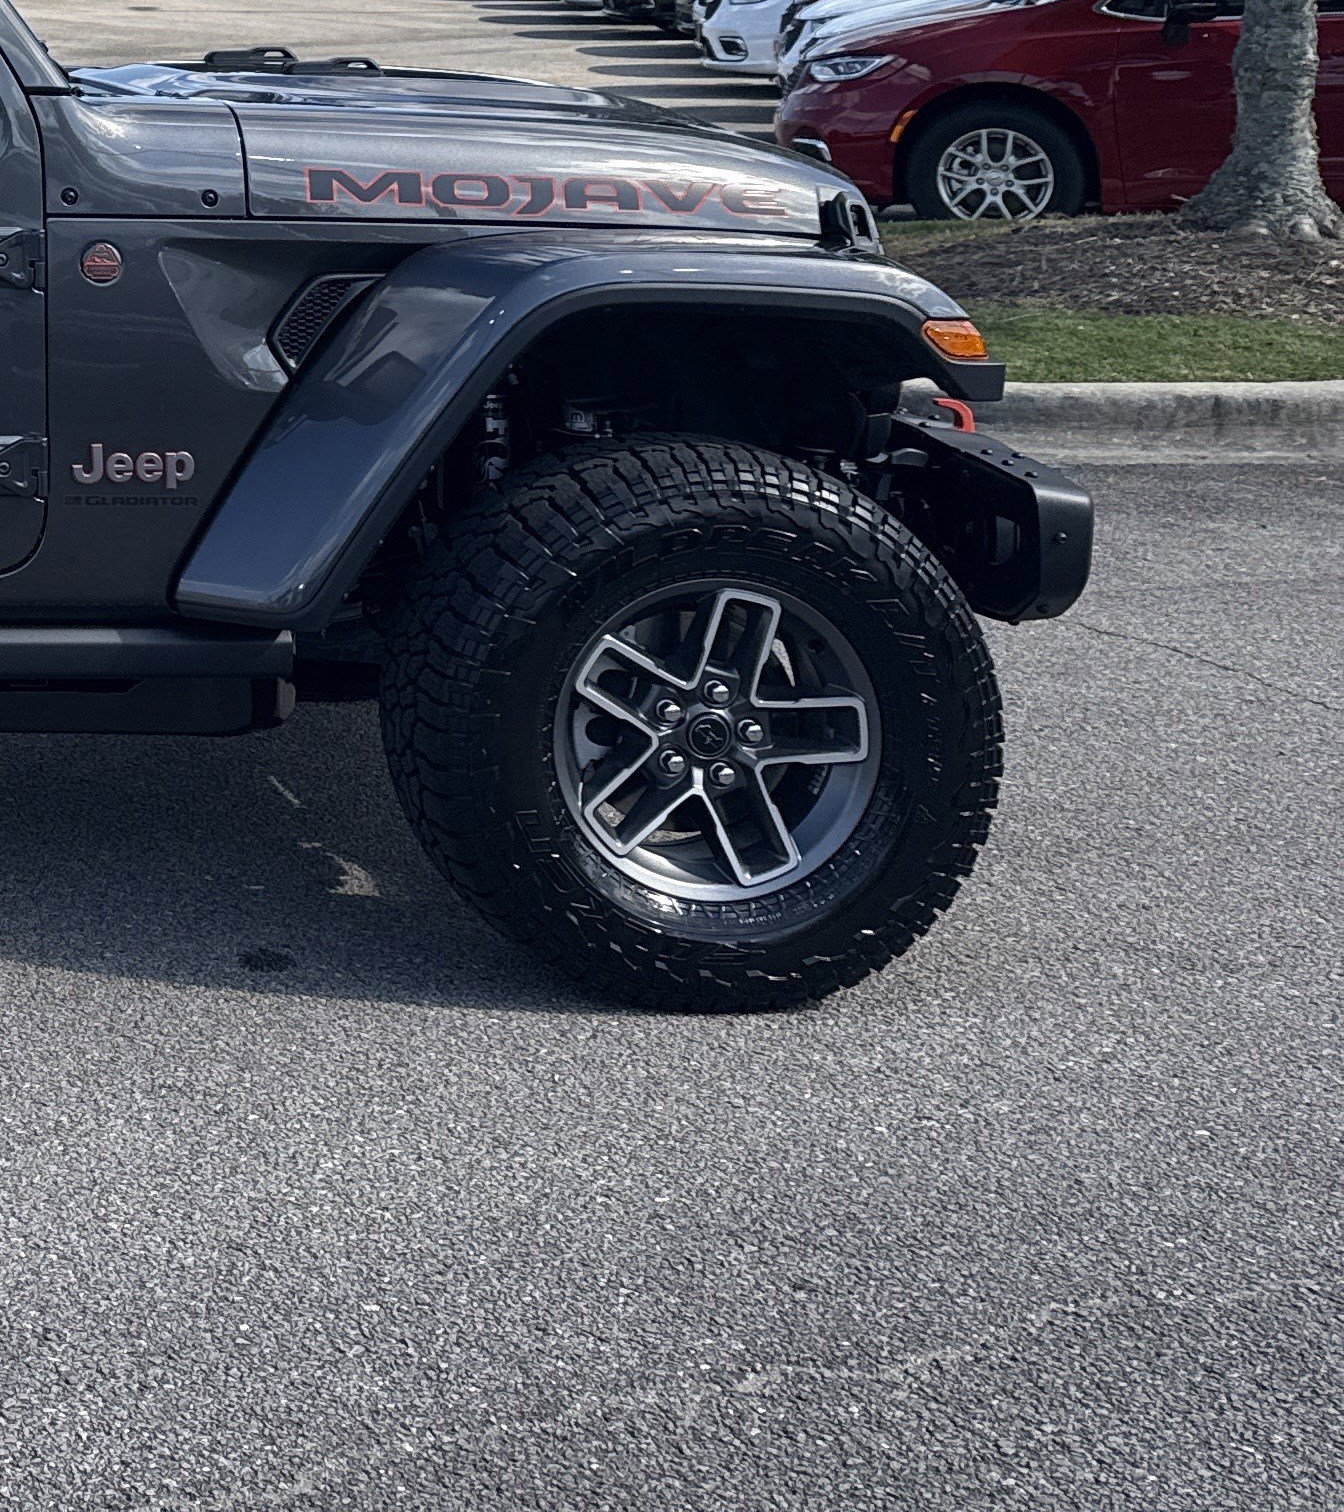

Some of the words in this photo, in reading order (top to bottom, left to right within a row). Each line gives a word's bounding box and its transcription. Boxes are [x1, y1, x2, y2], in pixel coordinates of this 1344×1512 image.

[305, 166, 788, 217] MOJAVE
[71, 443, 196, 490] Jeep
[85, 495, 199, 506] GLADIATOR
